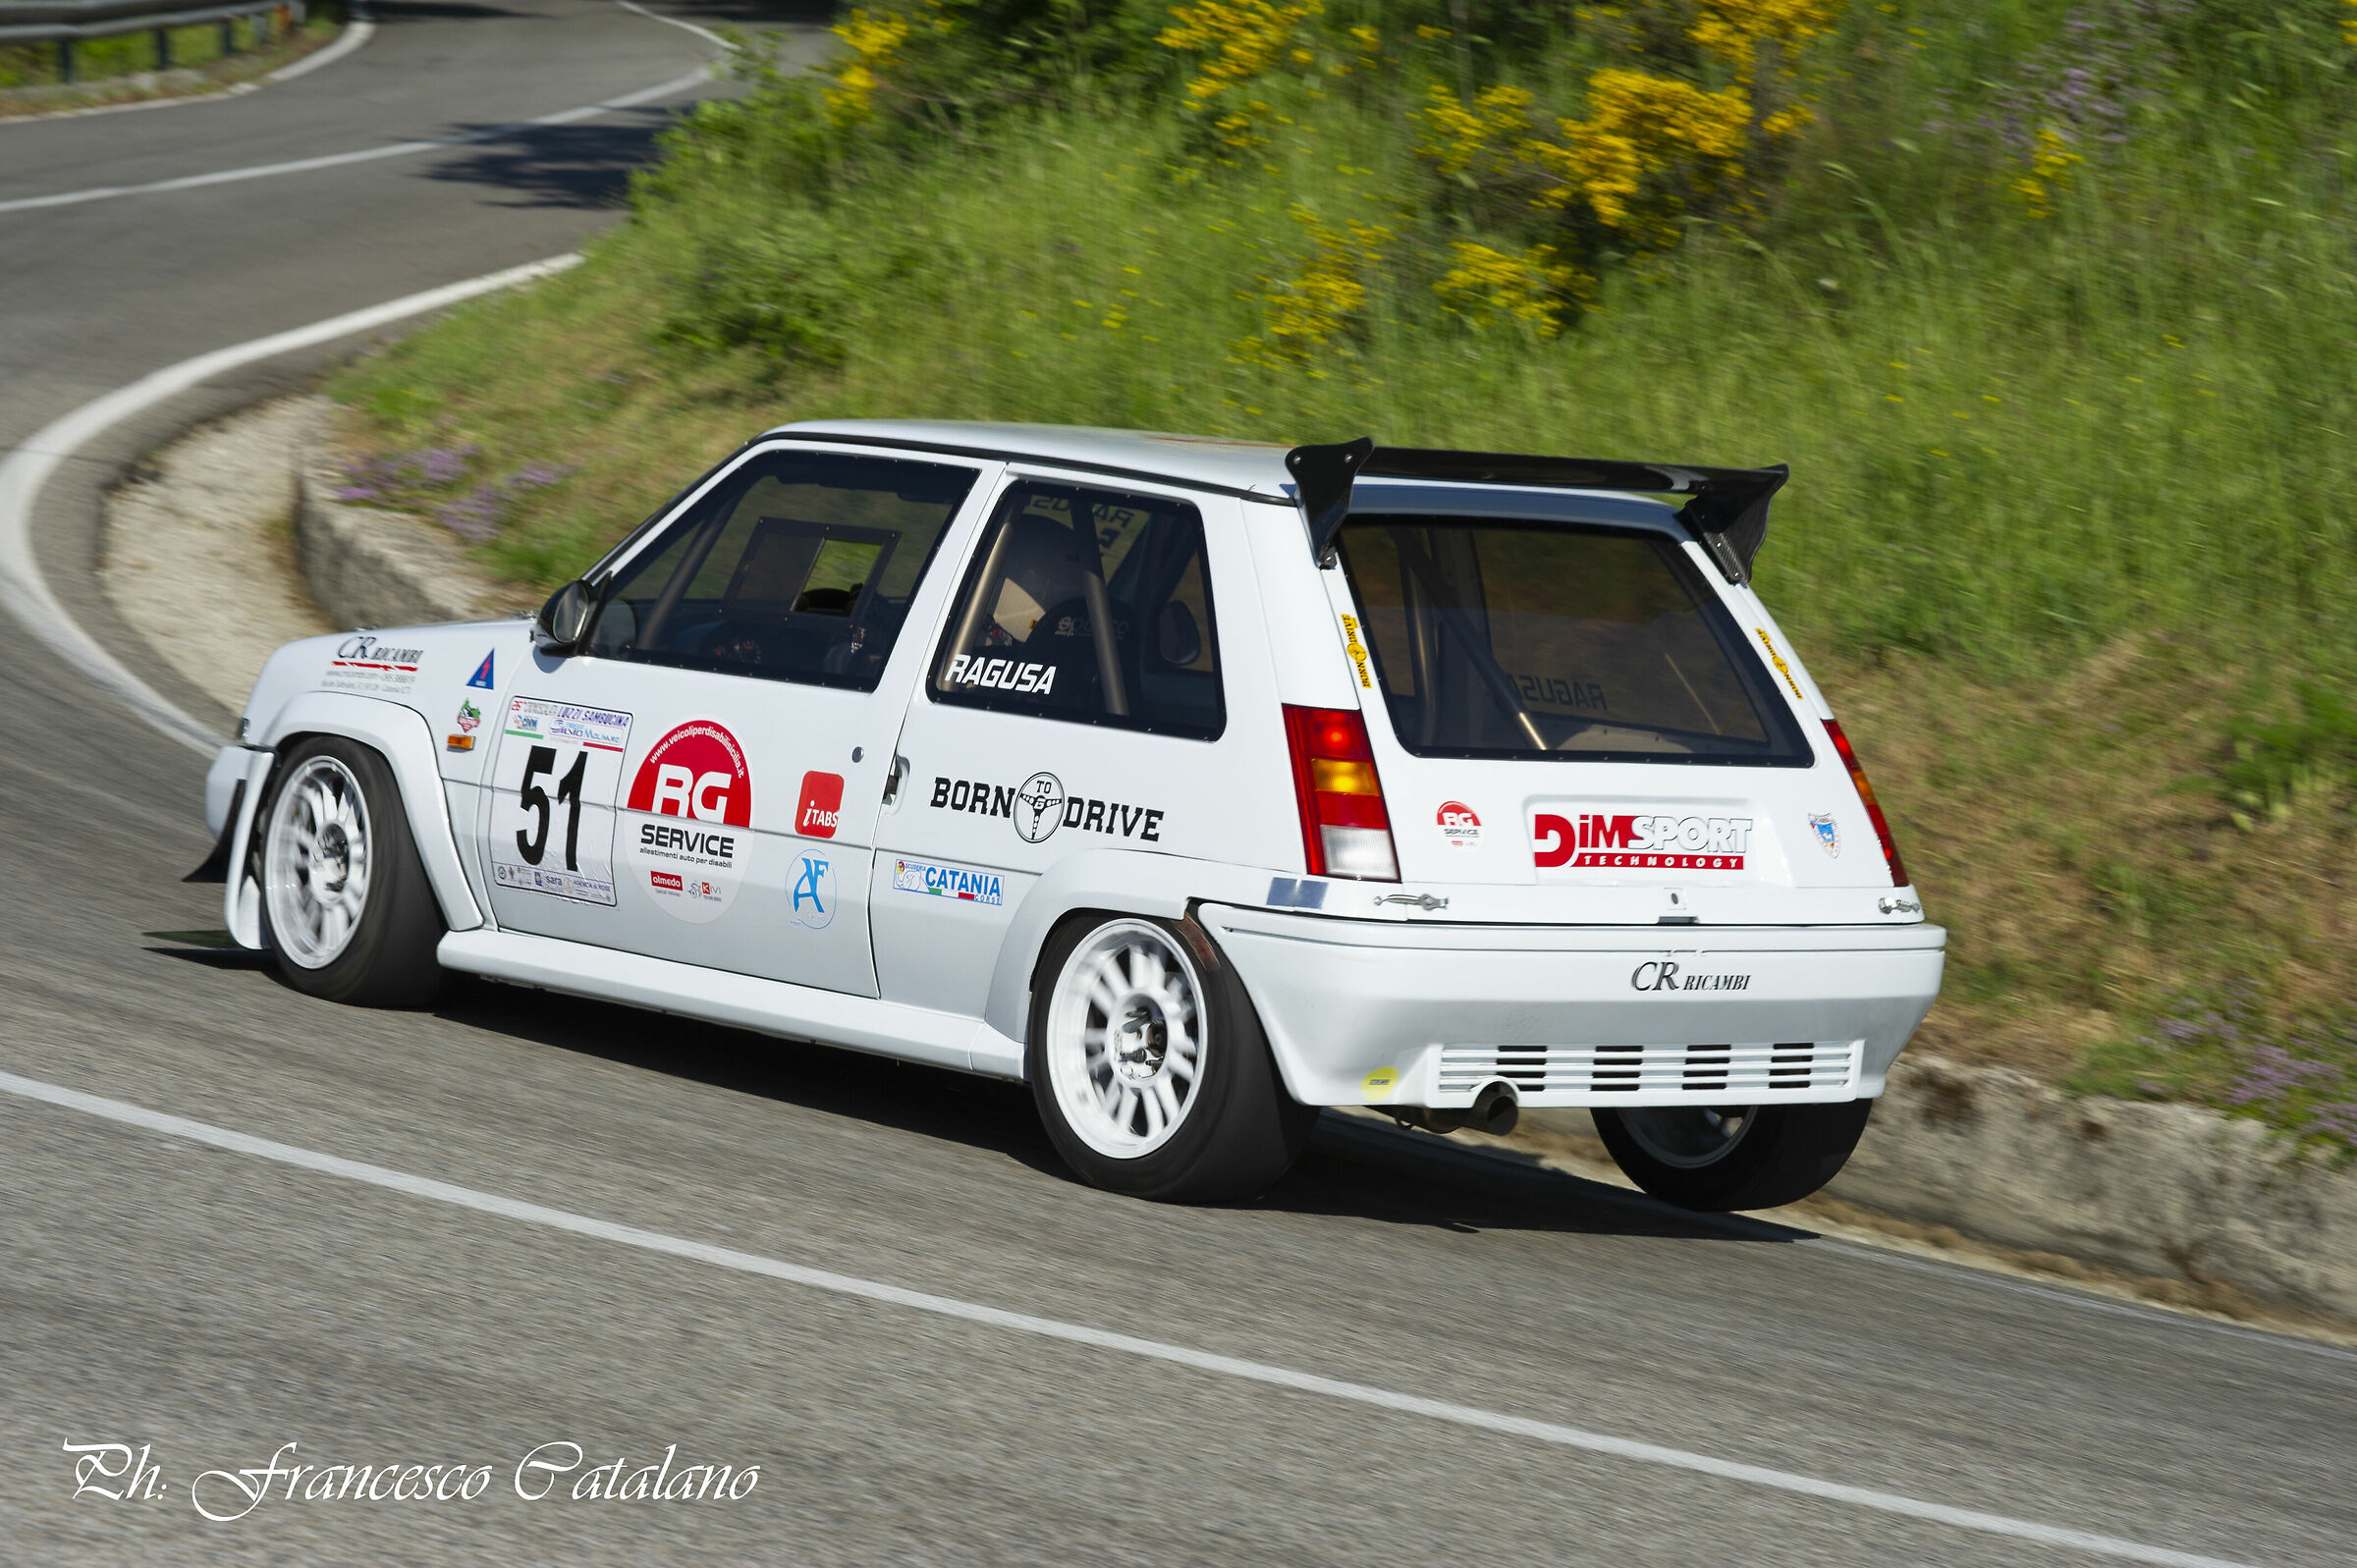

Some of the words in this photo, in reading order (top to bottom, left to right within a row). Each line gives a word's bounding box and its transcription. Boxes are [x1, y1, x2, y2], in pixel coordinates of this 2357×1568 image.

[338, 636, 377, 659] CR
[945, 654, 1057, 695] RAGUSA
[557, 706, 582, 721] LUZZI
[582, 710, 630, 728] SAMBUCINA
[651, 763, 732, 825] RG
[517, 745, 588, 872] 51
[802, 800, 838, 828] iTABS
[930, 777, 1015, 818] BORN
[1036, 781, 1053, 794] TO
[1063, 796, 1164, 841] DRIVE
[1443, 812, 1473, 826] RG
[640, 824, 735, 859] SERVICE
[639, 846, 678, 859] allestimenti
[679, 852, 694, 863] auto
[708, 859, 733, 869] disabili
[904, 862, 926, 872] SCUDERIA
[1583, 855, 1738, 866] TECHNOLOGY
[545, 876, 562, 887] sara
[925, 866, 1001, 896] CATANIA
[974, 893, 1001, 905] CORSE
[1631, 961, 1679, 992] CR
[1682, 975, 1752, 991] RICAMBI
